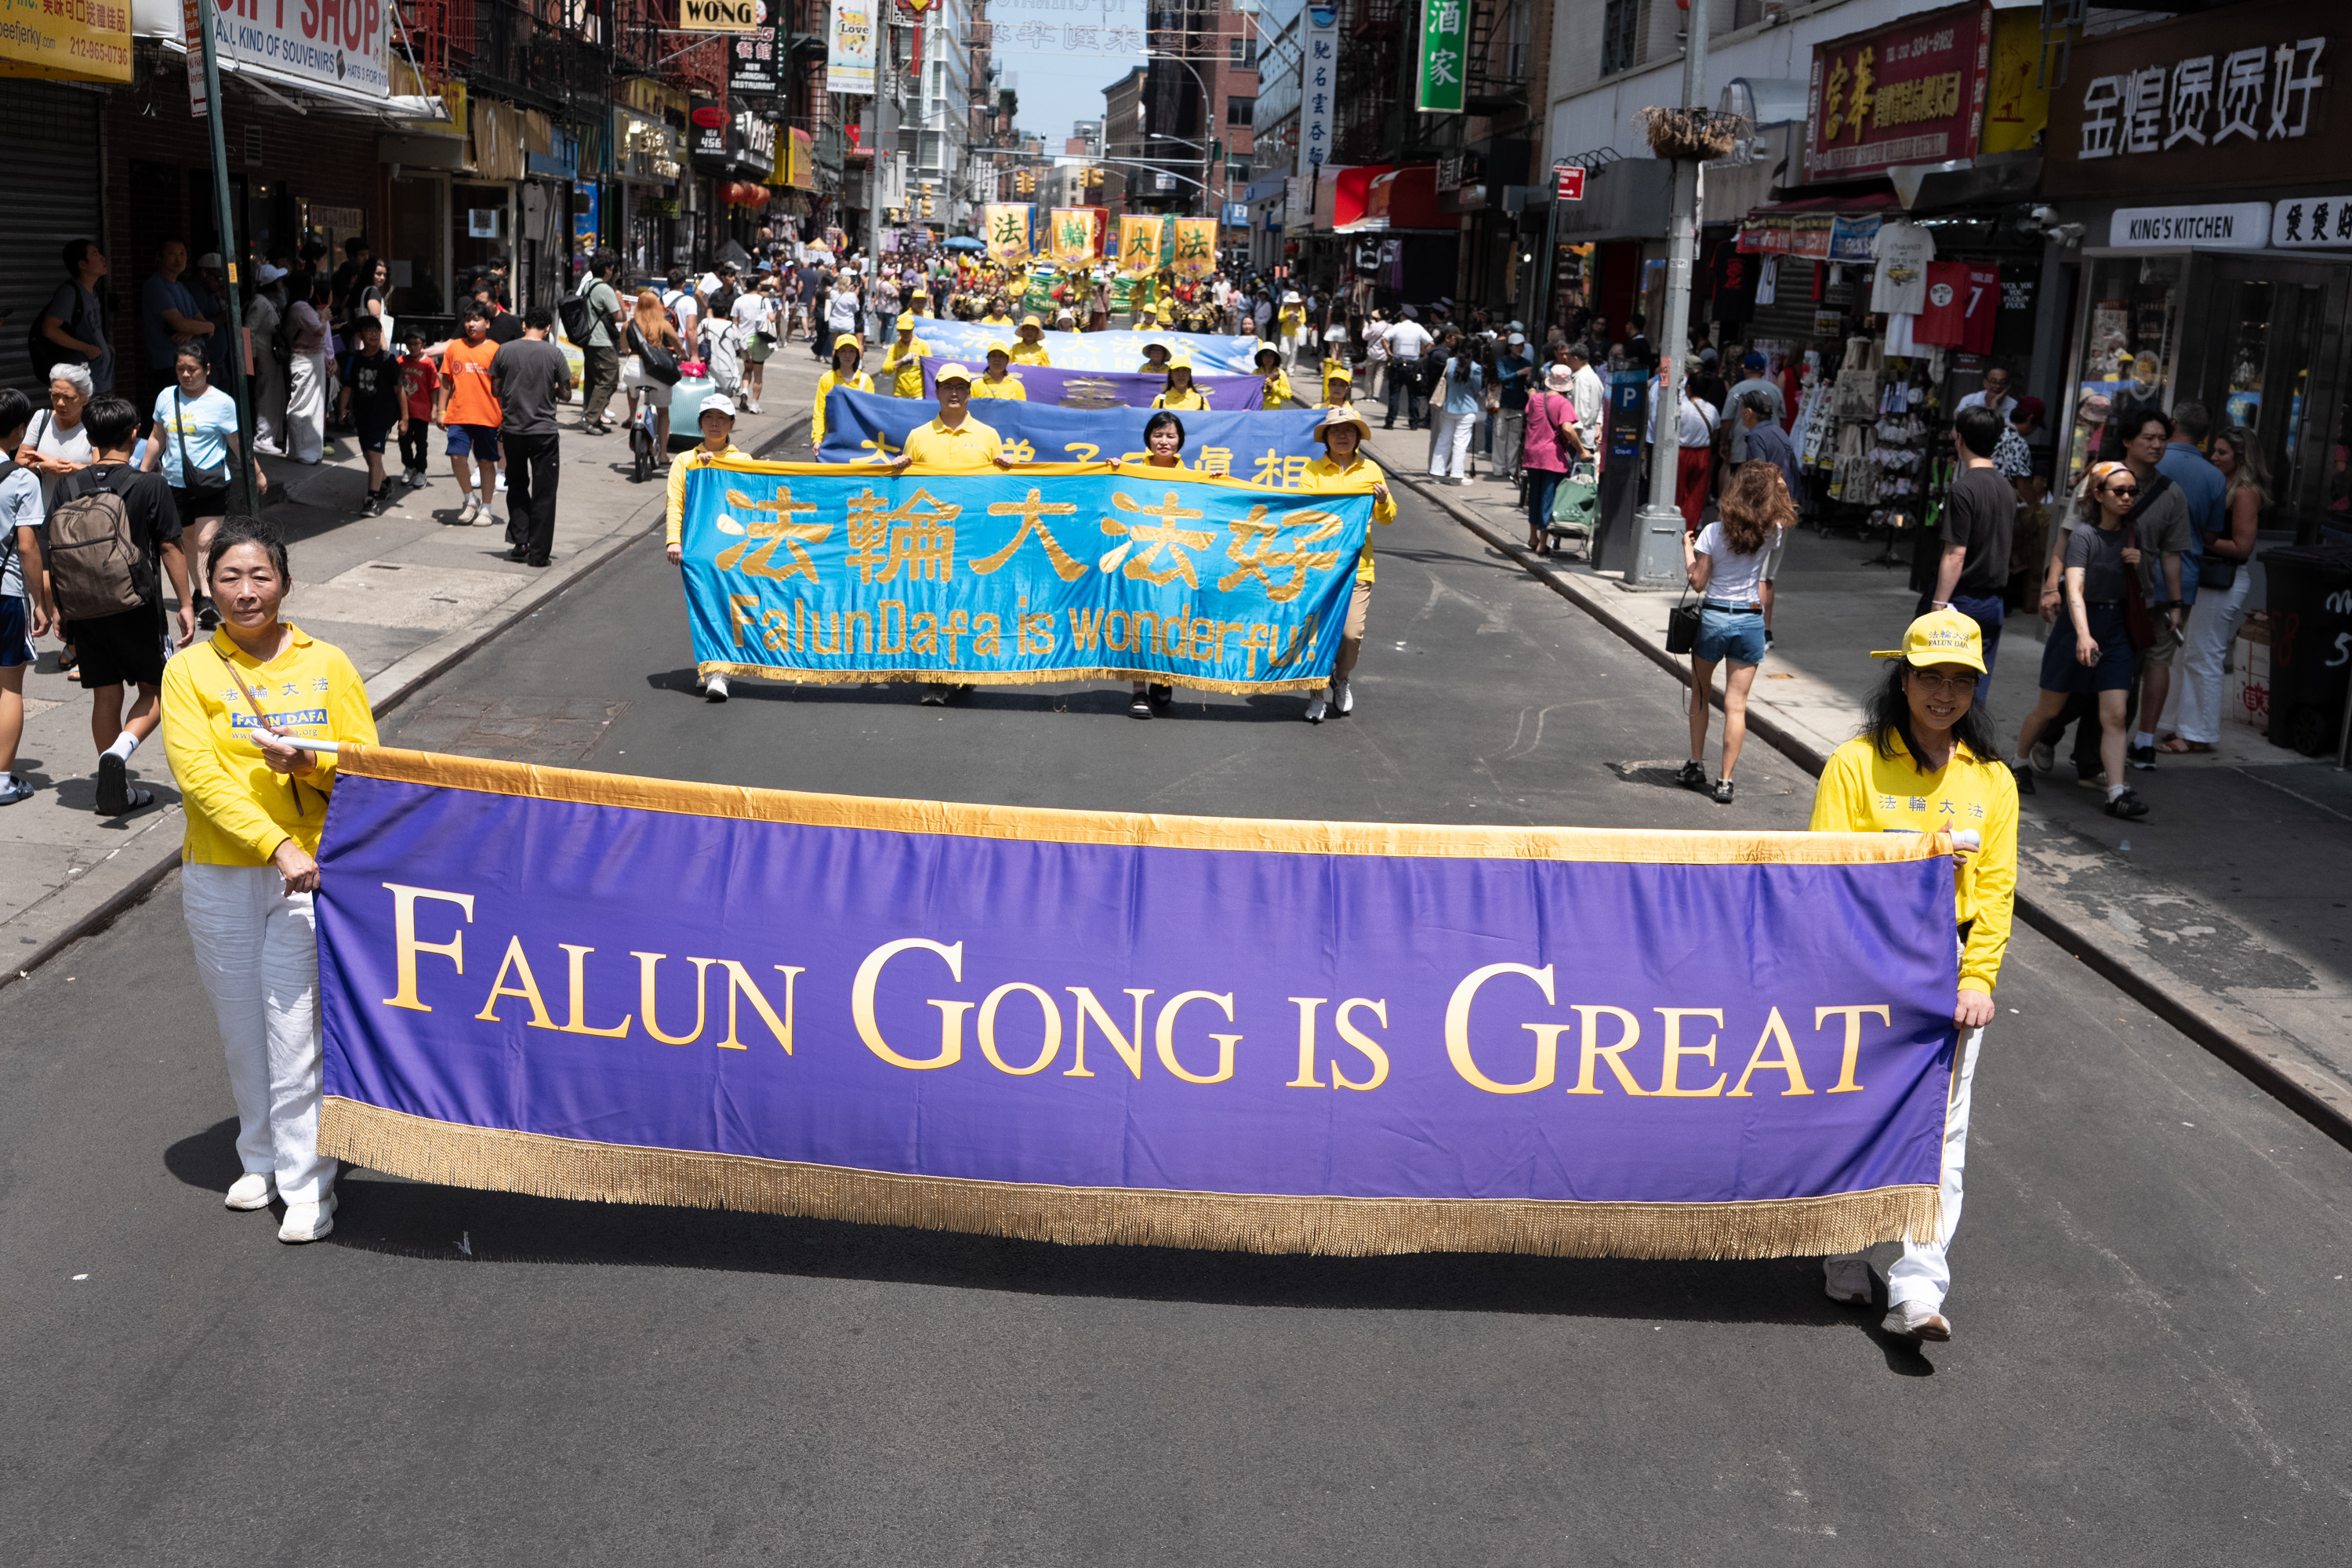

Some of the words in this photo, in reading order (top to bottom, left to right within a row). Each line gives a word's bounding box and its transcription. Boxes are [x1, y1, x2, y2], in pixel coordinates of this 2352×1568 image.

[685, 0, 751, 24] WONG
[300, 0, 379, 56] SHOP
[840, 23, 869, 34] Love
[70, 36, 128, 66] 212-965-0796
[215, 18, 236, 45] ALL
[238, 24, 263, 53] KIND
[266, 34, 280, 57] OF
[281, 38, 335, 74] SOUVENIRS
[347, 63, 361, 80] HATS
[361, 67, 365, 81] 3
[366, 68, 378, 84] FOR
[735, 42, 773, 60] 餐館
[1428, 0, 1461, 86] 酒家
[745, 63, 760, 71] NEW
[730, 81, 776, 91] RESTAURANT
[2078, 36, 2326, 161] 金煌煲煲好
[700, 137, 721, 148] 456
[994, 213, 1023, 244] 法
[1127, 227, 1156, 256] 大
[2129, 216, 2172, 240] KING'S
[2174, 216, 2234, 238] KITCHEN
[1179, 228, 1209, 259] 法
[1964, 285, 1984, 318] 7
[963, 328, 1200, 358] 法大法好
[1622, 387, 1637, 408] P
[715, 485, 1346, 604] 法輪大法好
[1017, 594, 1055, 655] is
[1071, 603, 1323, 679] wonderful!
[220, 677, 329, 702] 法輪大法
[286, 710, 326, 725] DAFA
[1878, 794, 1984, 819] 法輪大法
[380, 881, 807, 1058] FALUN
[851, 936, 1244, 1085] GONG
[1285, 995, 1391, 1093] IS
[1443, 961, 1892, 1098] GREAT
